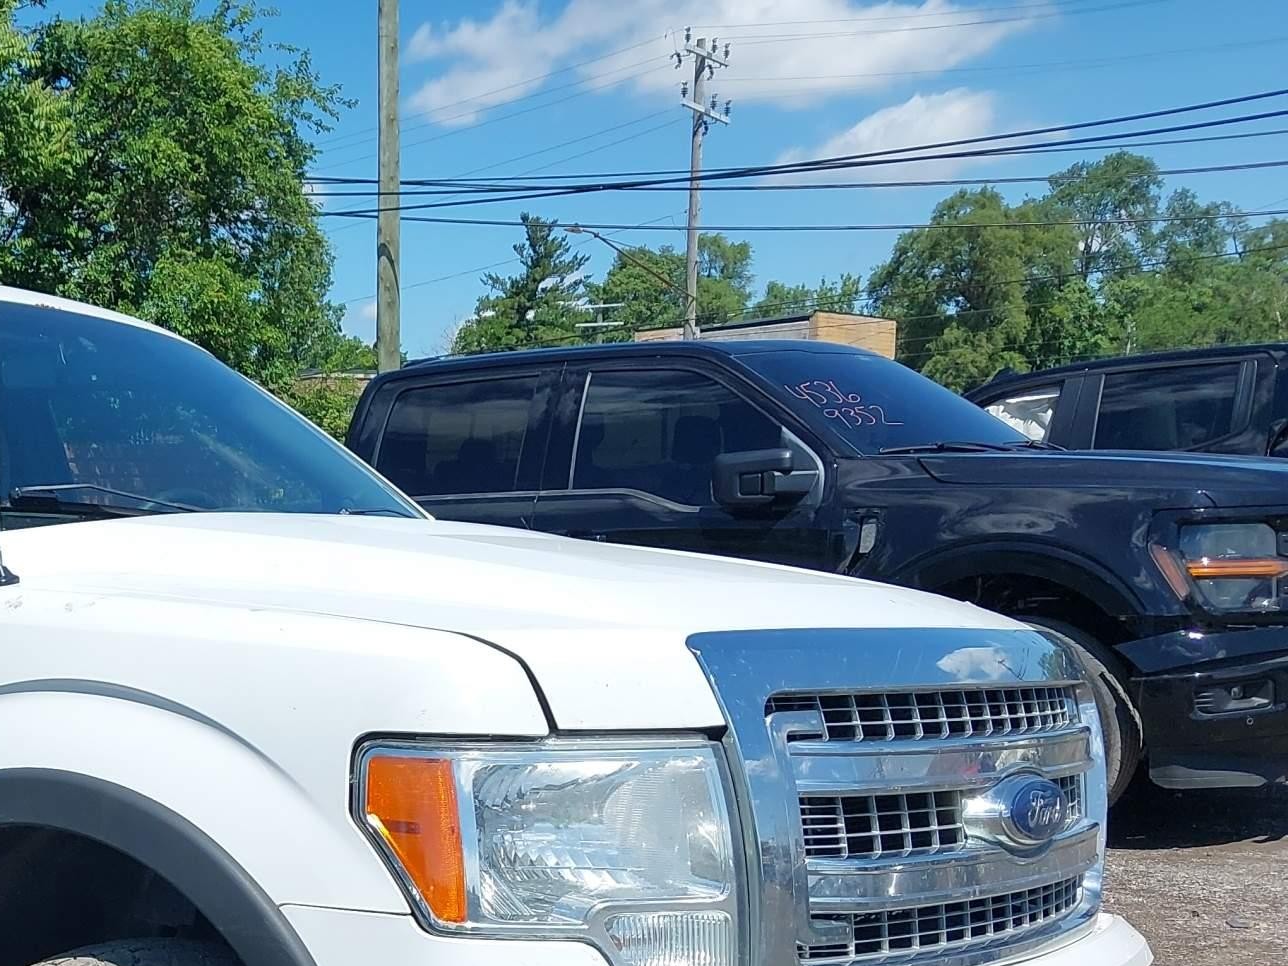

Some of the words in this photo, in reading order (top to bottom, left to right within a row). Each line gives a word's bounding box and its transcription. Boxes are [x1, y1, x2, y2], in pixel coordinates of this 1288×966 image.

[783, 380, 861, 408] 4536
[823, 405, 905, 429] 9352
[1028, 790, 1062, 829] Ford
